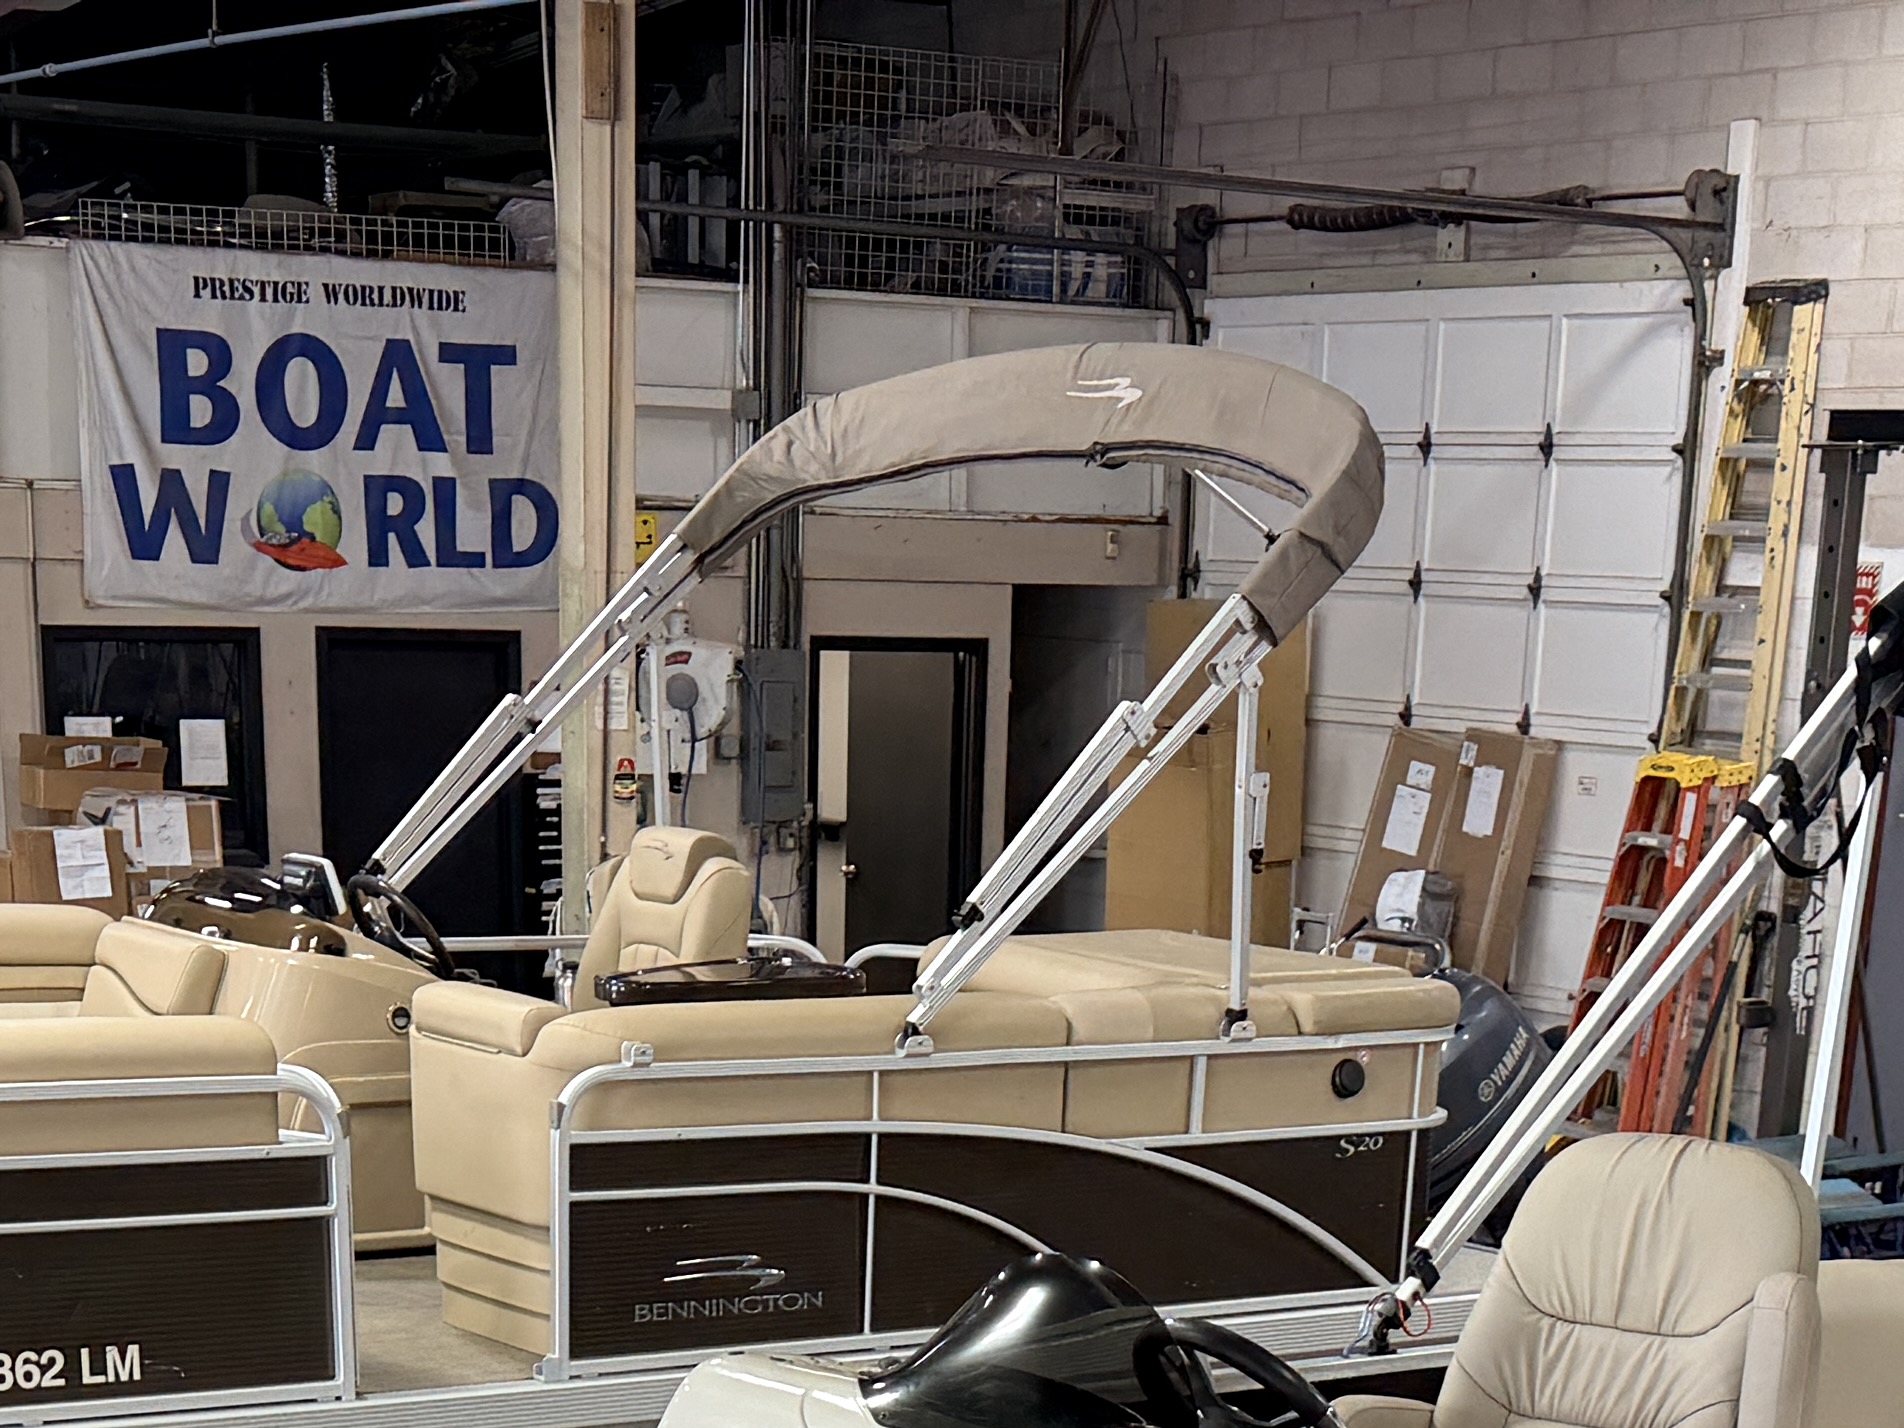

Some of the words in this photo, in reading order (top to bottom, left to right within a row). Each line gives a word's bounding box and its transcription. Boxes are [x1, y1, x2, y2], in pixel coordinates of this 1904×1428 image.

[192, 275, 310, 305] PRESTIGE
[321, 282, 467, 314] WORLDWIDE
[156, 327, 517, 455] BOAT
[1490, 1025, 1530, 1087] YAMAHA
[1334, 1135, 1384, 1159] S20
[634, 1290, 824, 1323] BENNINGTON
[80, 1344, 142, 1385] LM
